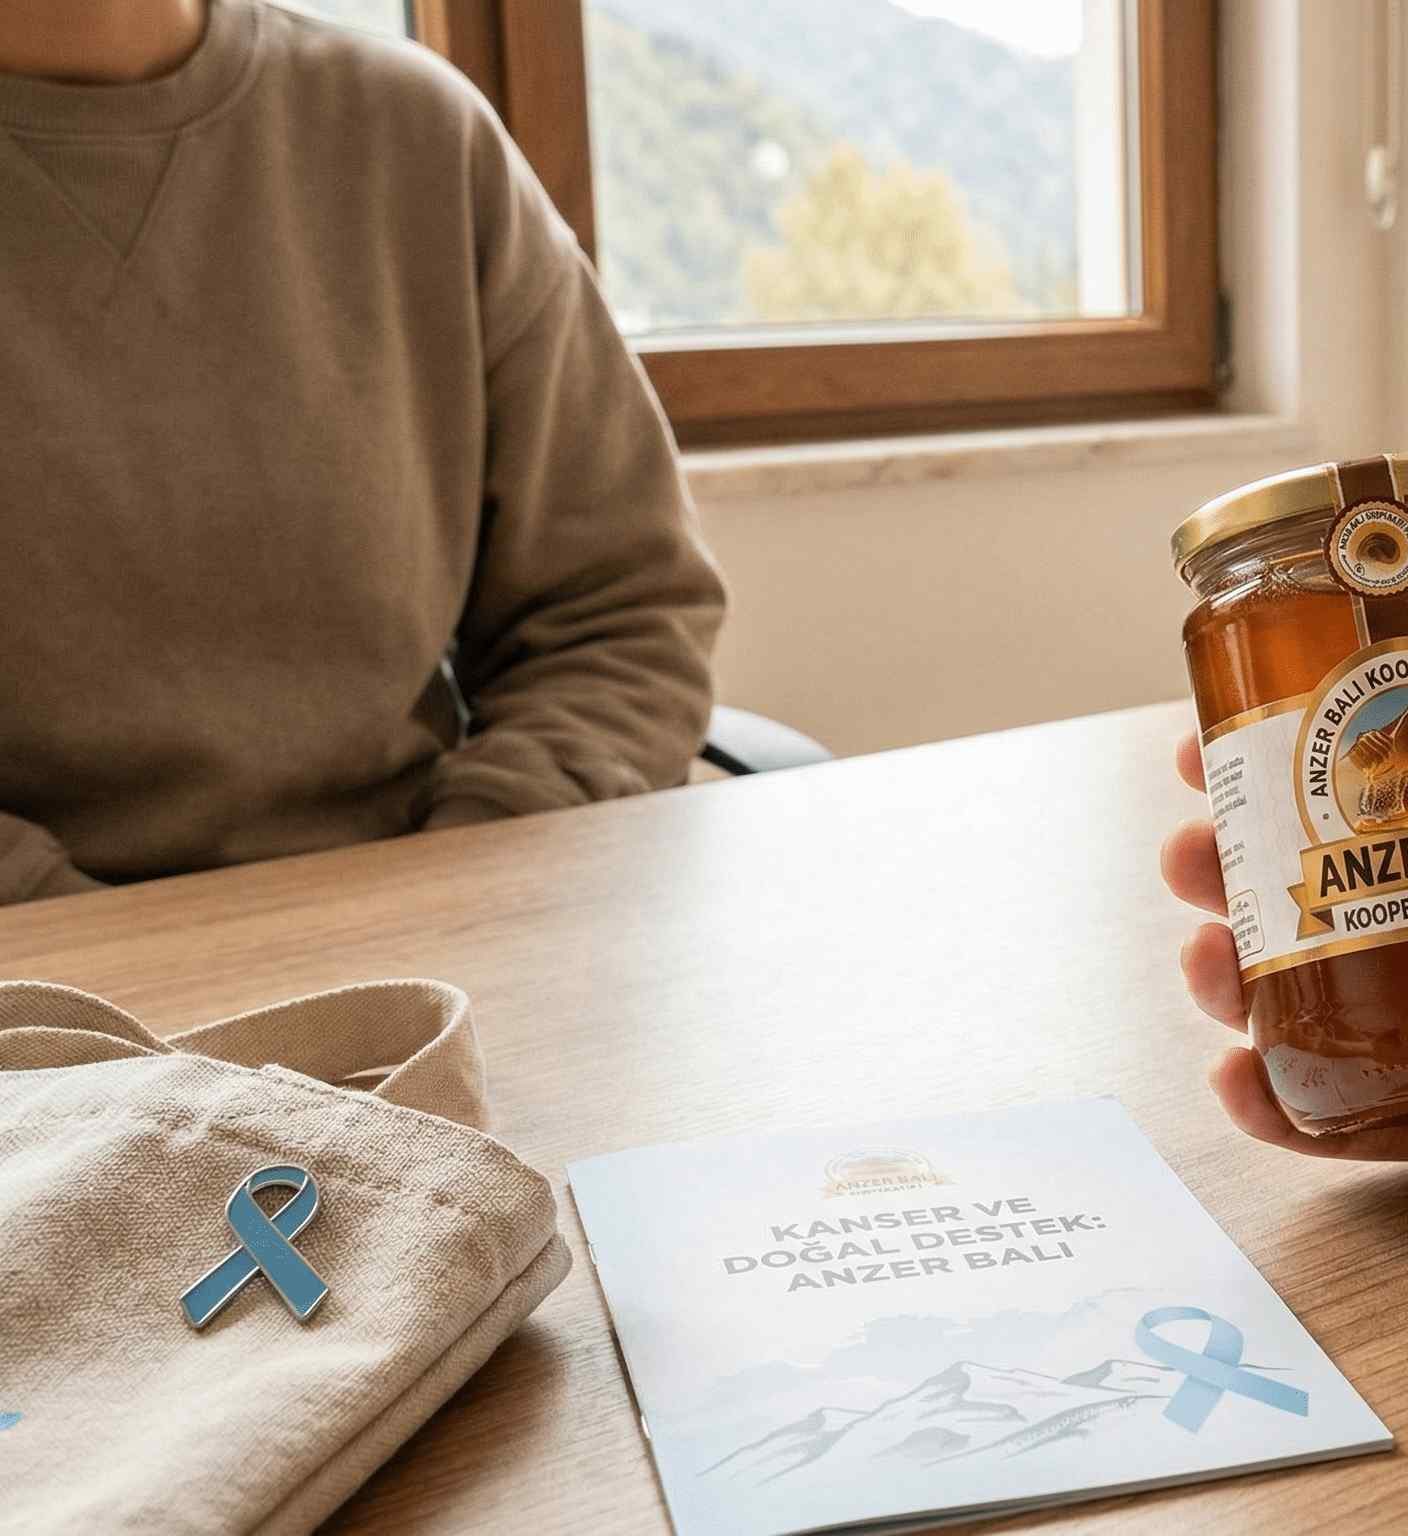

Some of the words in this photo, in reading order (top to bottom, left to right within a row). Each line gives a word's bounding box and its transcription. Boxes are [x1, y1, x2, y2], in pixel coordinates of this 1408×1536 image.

[1309, 727, 1335, 797] ANZER
[1324, 680, 1366, 727] BALI
[723, 1239, 901, 1275] DOĞAL
[911, 1214, 1107, 1251] DESTEK:
[770, 1206, 964, 1242] KANSER
[973, 1197, 1037, 1217] VE
[786, 1257, 955, 1293] ANZER
[963, 1241, 1075, 1271] BALI
